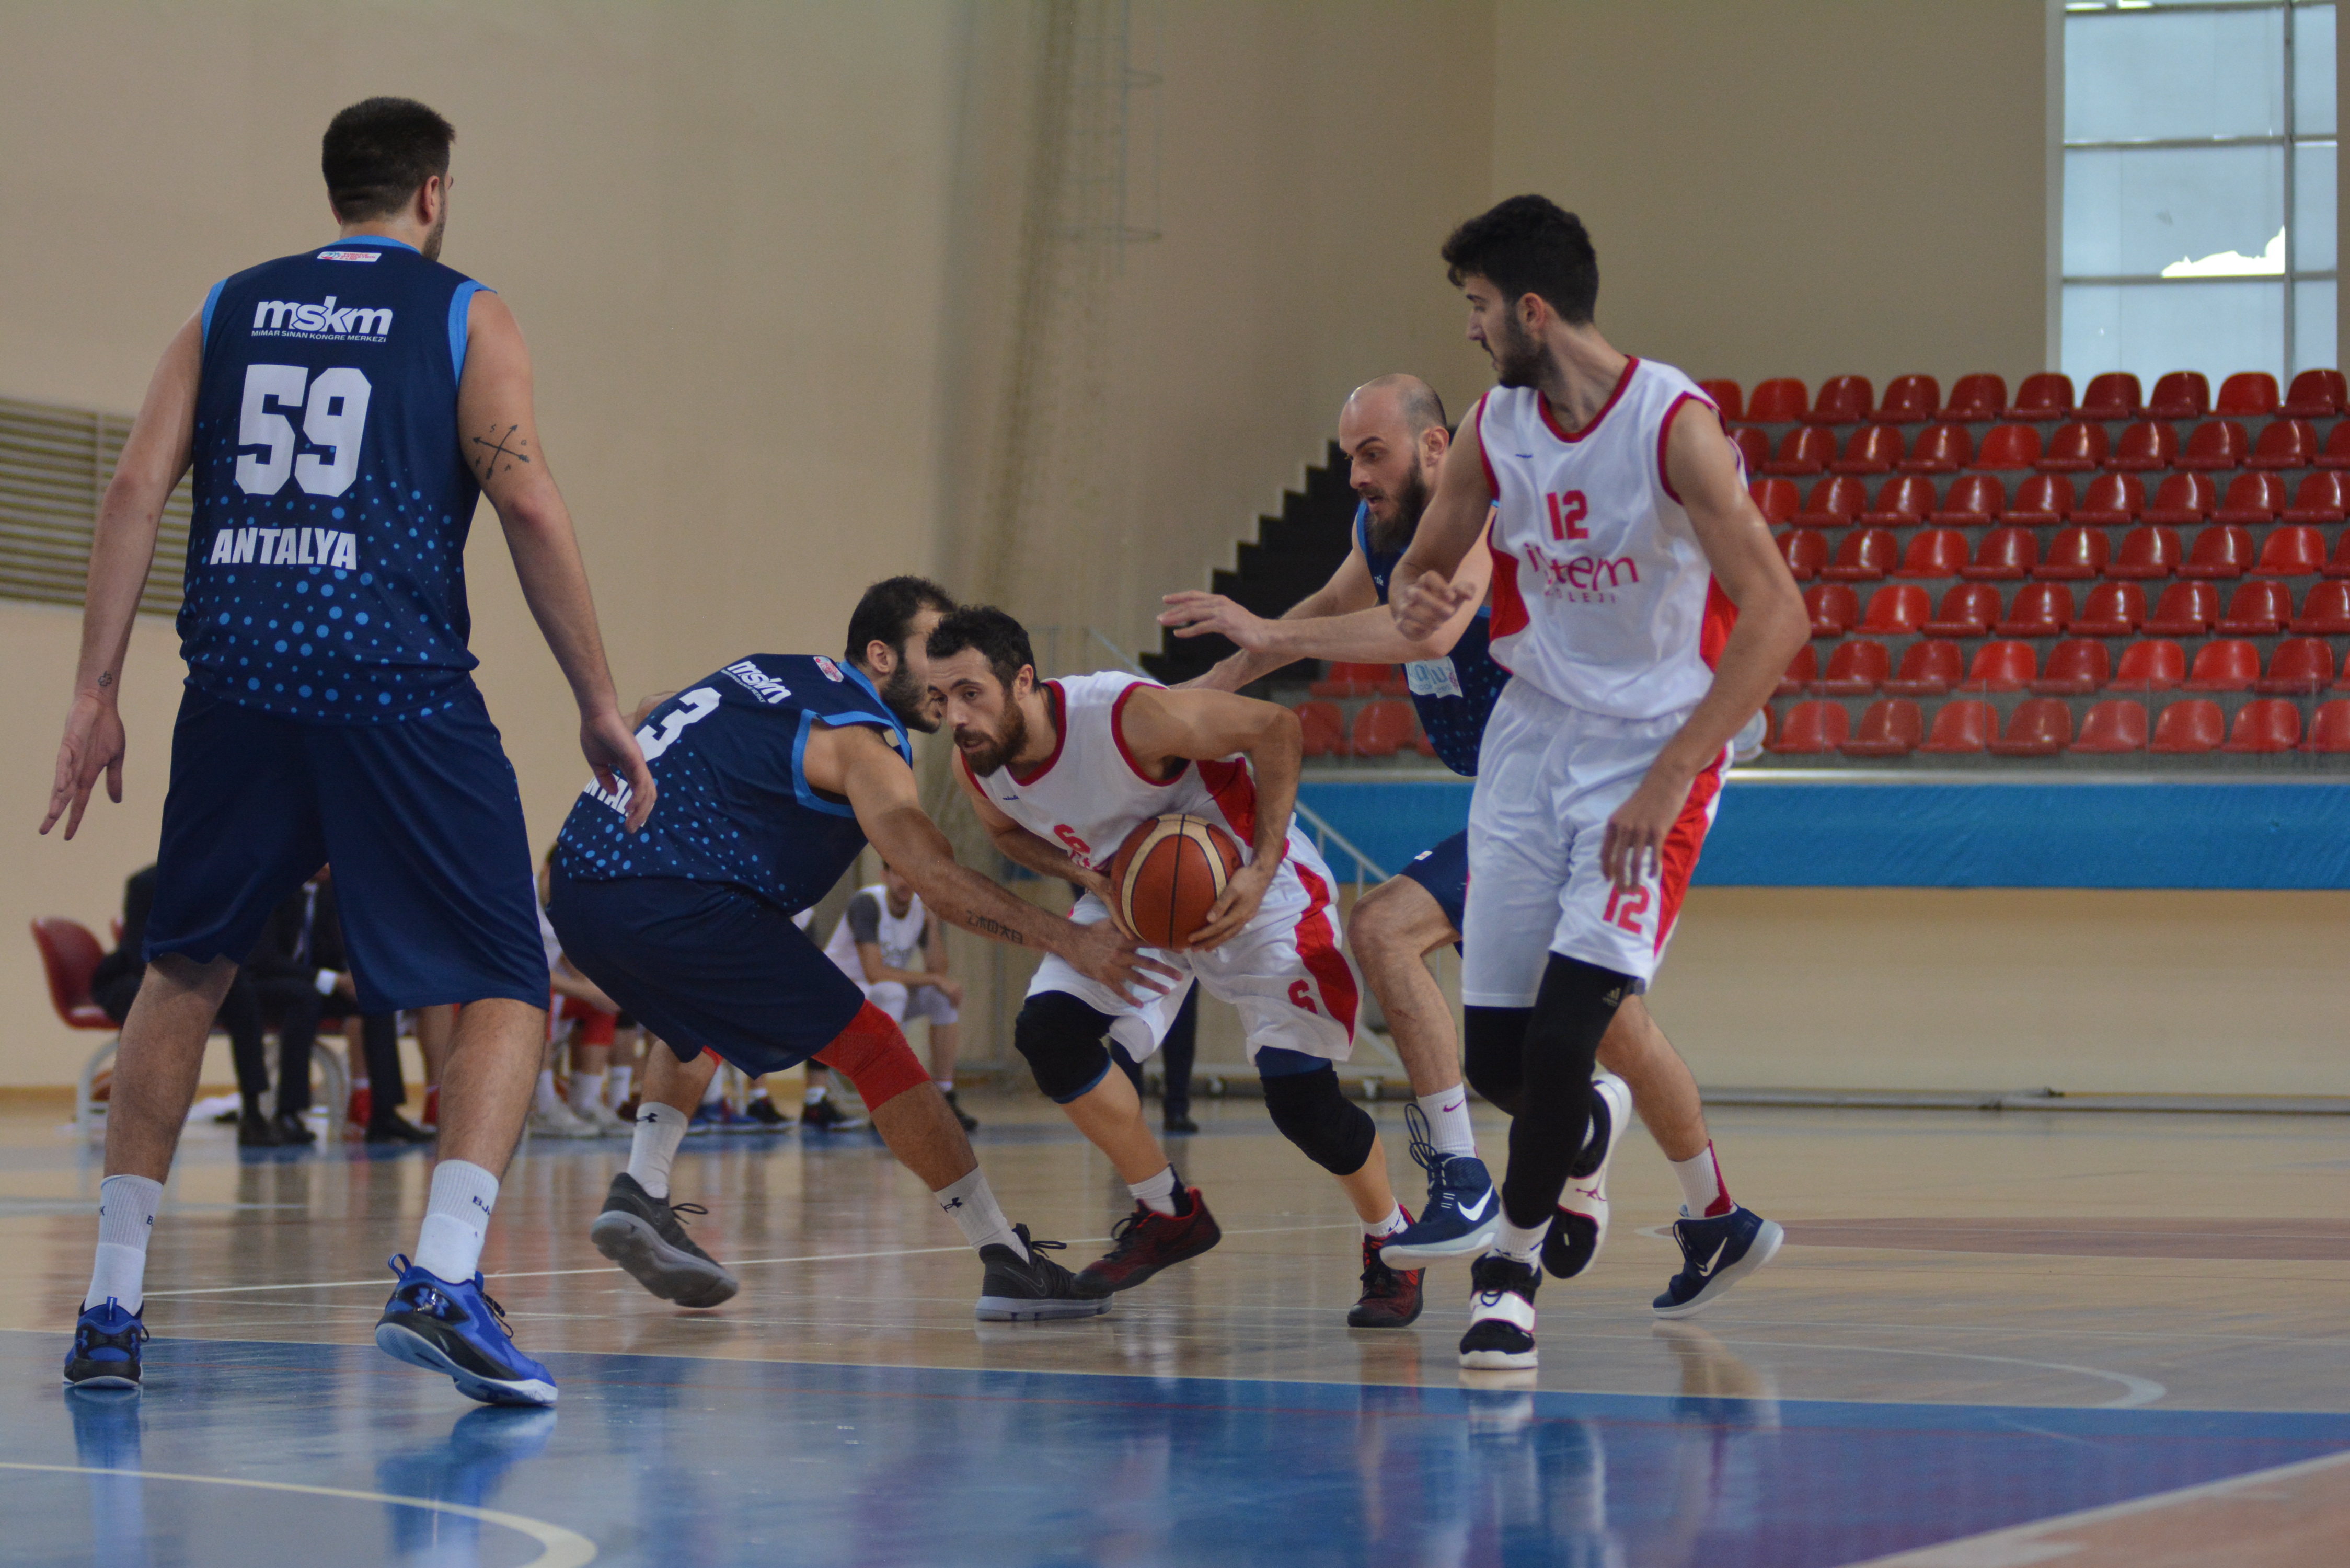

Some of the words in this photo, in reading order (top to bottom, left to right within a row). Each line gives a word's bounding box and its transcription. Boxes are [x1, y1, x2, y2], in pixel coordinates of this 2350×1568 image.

[253, 296, 393, 335] mskm
[235, 364, 372, 498] 59
[1547, 490, 1589, 541] 12
[210, 527, 357, 570] ANTALYA
[635, 687, 722, 762] 3
[1053, 824, 1090, 854] 6
[1602, 883, 1650, 935] 12
